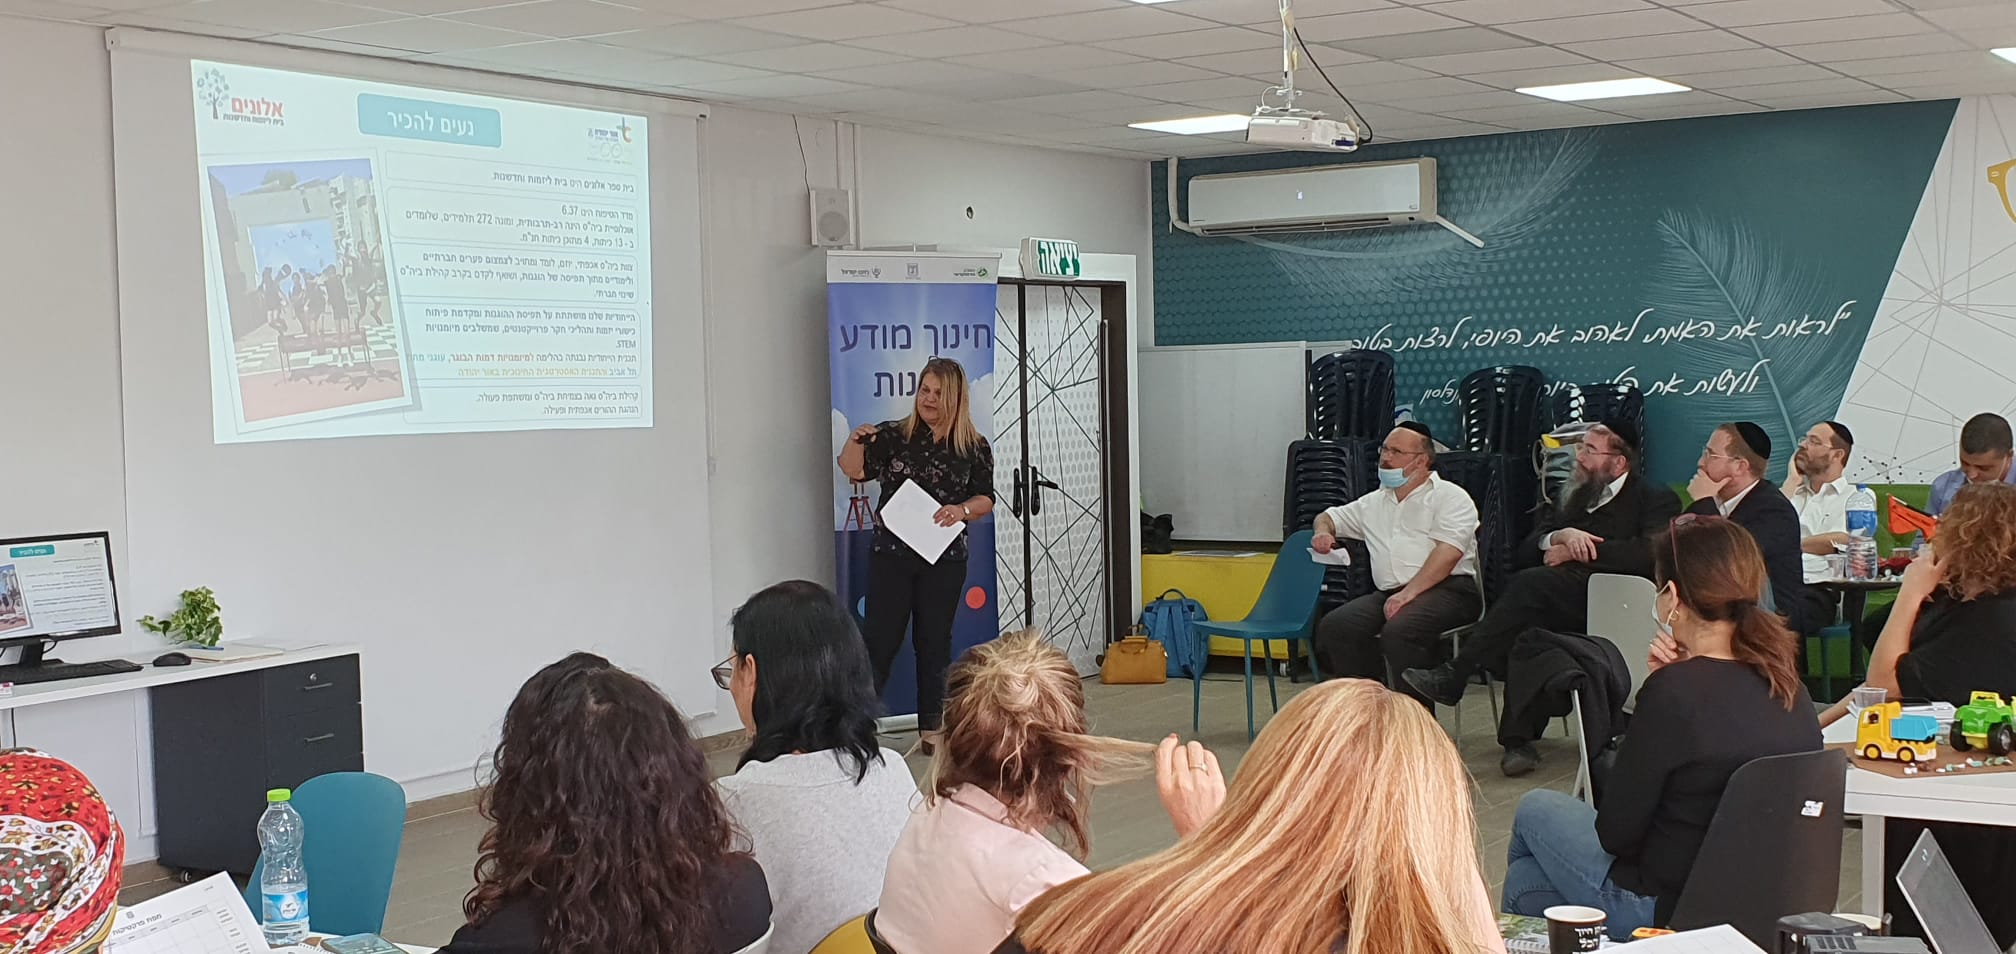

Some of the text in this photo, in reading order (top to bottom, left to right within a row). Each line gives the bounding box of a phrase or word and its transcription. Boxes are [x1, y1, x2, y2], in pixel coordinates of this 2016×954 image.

[231, 96, 284, 118] אלונים
[387, 110, 474, 137] נעים להכיר
[554, 177, 567, 187] בית
[584, 179, 605, 190] אלונים
[607, 183, 621, 192] ספר
[622, 183, 634, 193] בית
[406, 210, 439, 221] שלומדים
[561, 205, 578, 216] 6.37
[621, 211, 633, 220] מדד
[476, 213, 492, 224] 272
[584, 235, 589, 245] 4
[615, 237, 623, 247] 13
[423, 253, 457, 262] חברתיים
[459, 254, 482, 263] פערים
[1038, 240, 1080, 276] יציאה
[400, 265, 423, 276] ביה"ס
[426, 267, 449, 279] קהילת
[452, 270, 471, 280] בקרב
[474, 270, 493, 280] לקדם
[547, 272, 558, 281] של
[425, 309, 448, 317] פיתוח
[451, 309, 482, 319] ומקדמת
[517, 311, 541, 319] תפיסת
[543, 310, 552, 319] על
[551, 326, 566, 336] חקר
[1570, 308, 1654, 344] לאהוב
[1716, 316, 1762, 341] את
[1393, 316, 1472, 352] לרצות
[1523, 324, 1565, 347] את
[840, 324, 991, 355] חינוך מודע
[1683, 359, 1771, 396] ולעשות
[1643, 373, 1685, 397] את
